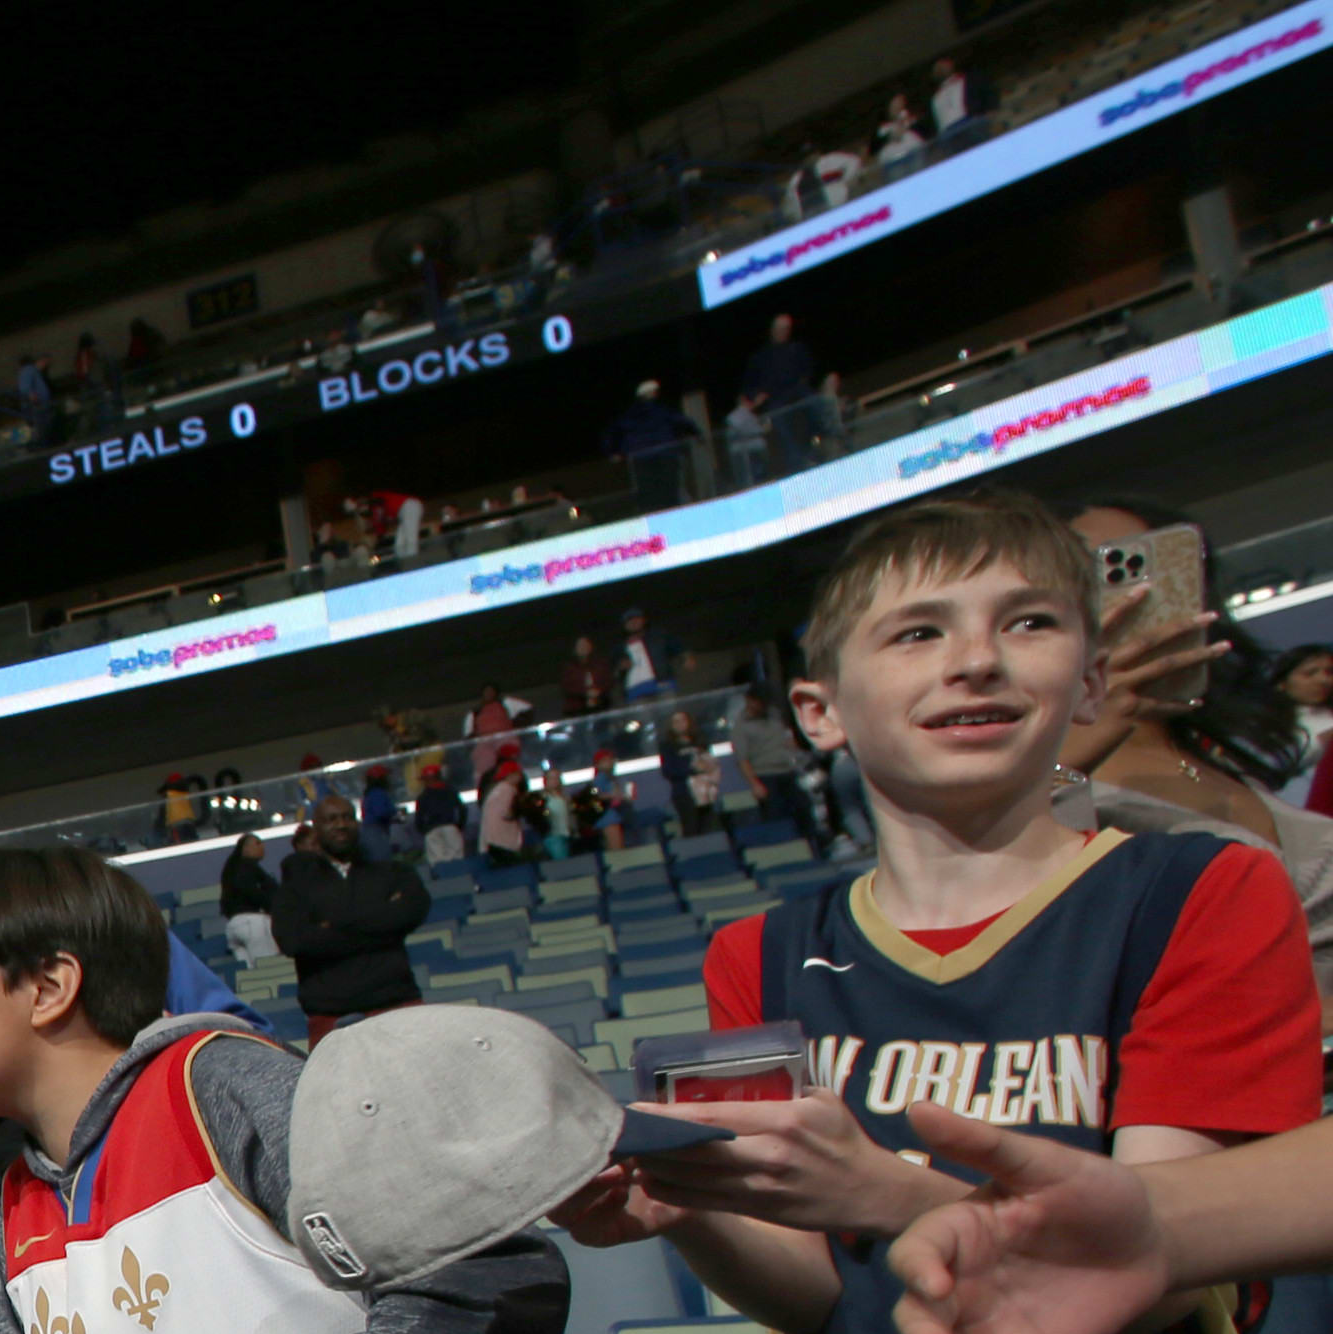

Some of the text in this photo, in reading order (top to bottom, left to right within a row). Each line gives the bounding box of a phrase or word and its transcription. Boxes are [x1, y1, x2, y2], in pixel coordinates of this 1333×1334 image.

[49, 416, 208, 484] STEALS
[231, 403, 257, 438] 0
[318, 332, 511, 410] BLOCKS
[542, 314, 573, 353] 0
[865, 1033, 1107, 1127] ORLEAN
